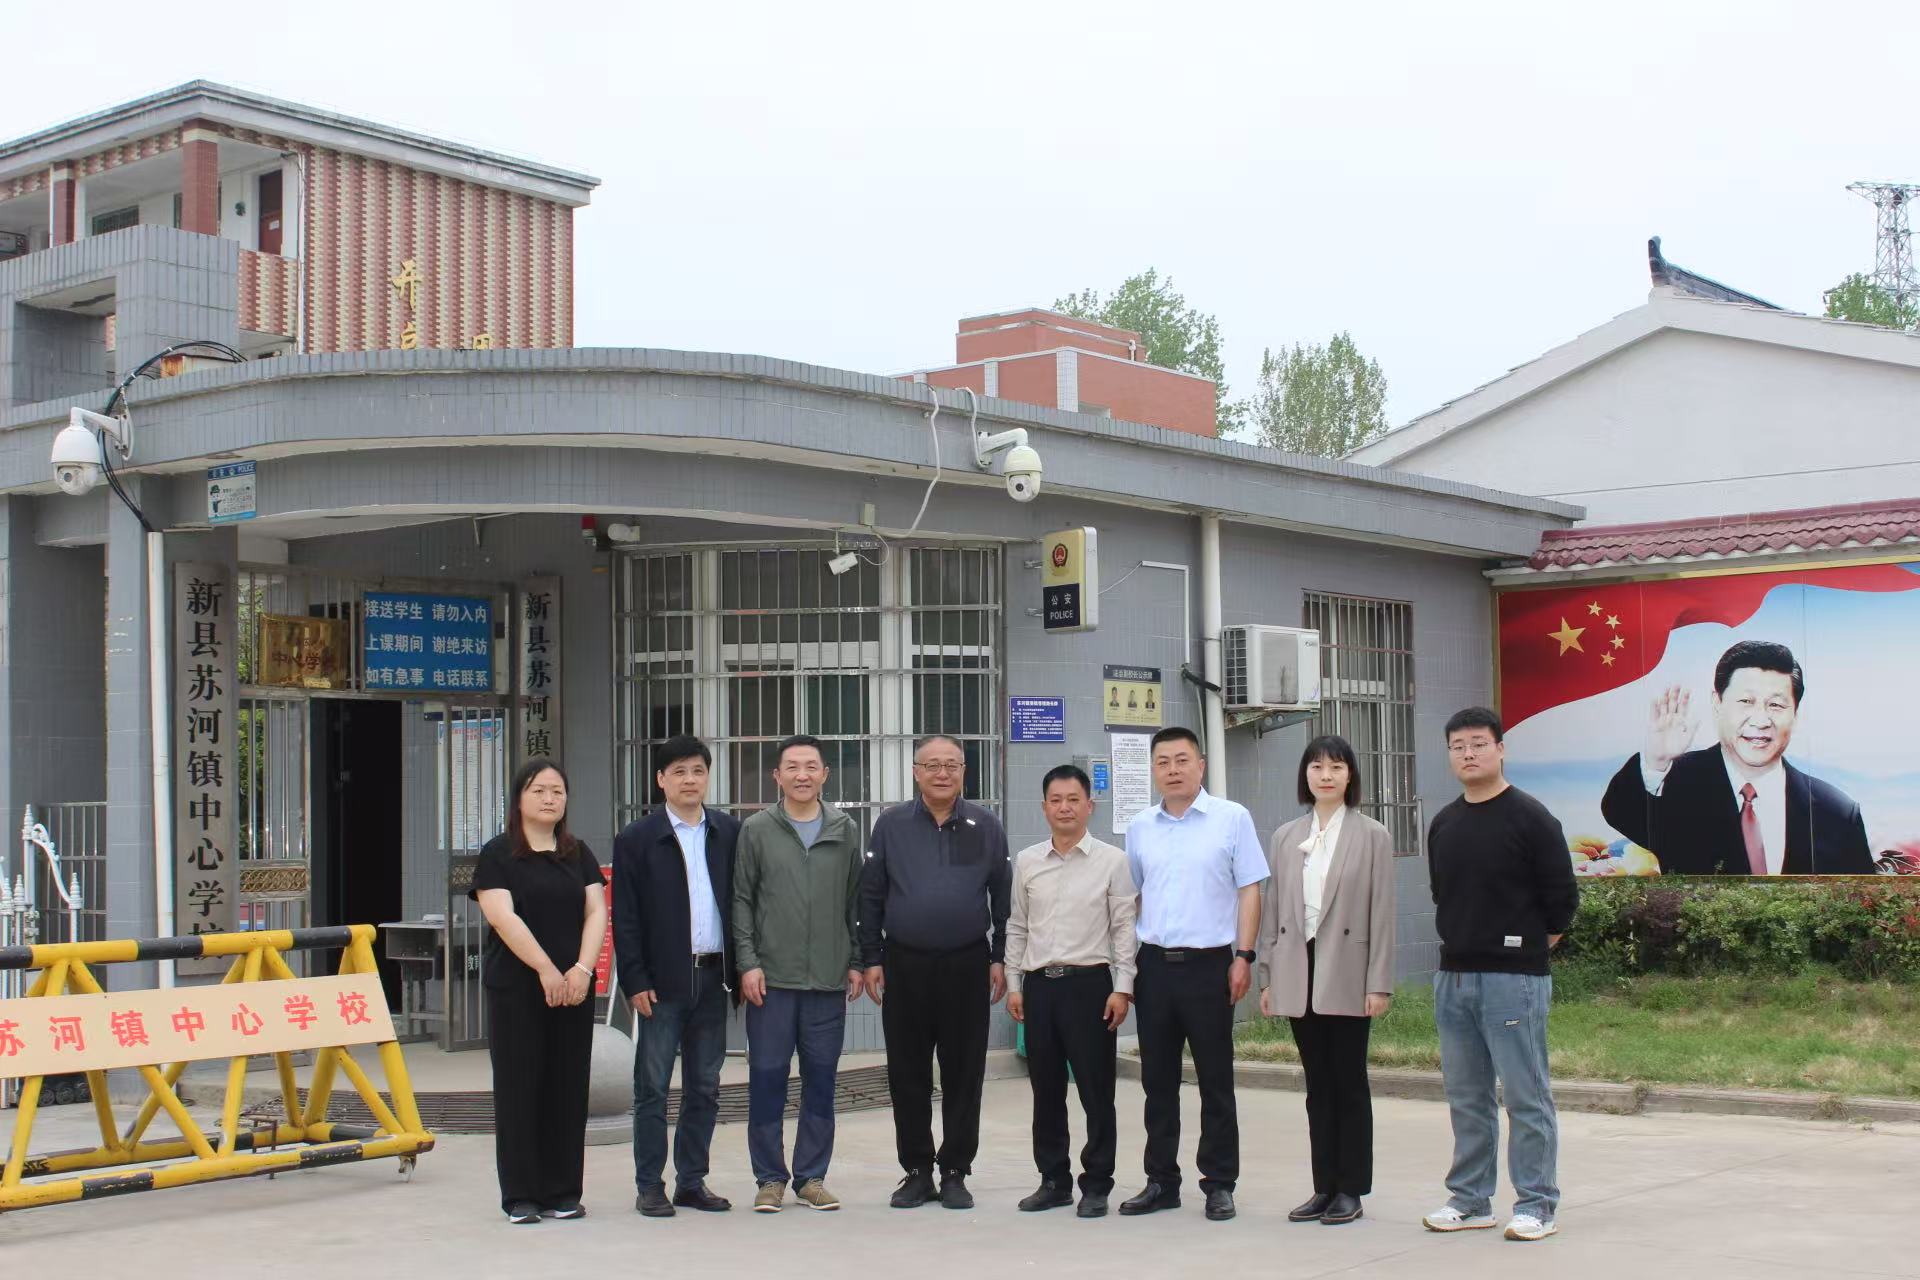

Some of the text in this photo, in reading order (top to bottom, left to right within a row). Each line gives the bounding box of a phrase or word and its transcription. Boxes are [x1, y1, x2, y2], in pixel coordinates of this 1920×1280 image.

[1051, 592, 1072, 606] 公安
[365, 600, 487, 624] 接送学生 请勿入内
[1050, 609, 1073, 620] POLICE
[365, 633, 488, 655] 上课期间 谢绝来访
[365, 667, 488, 687] 如有急事 电话联系
[524, 591, 552, 757] 新县苏河镇
[0, 991, 372, 1056] 苏河镇中心学校
